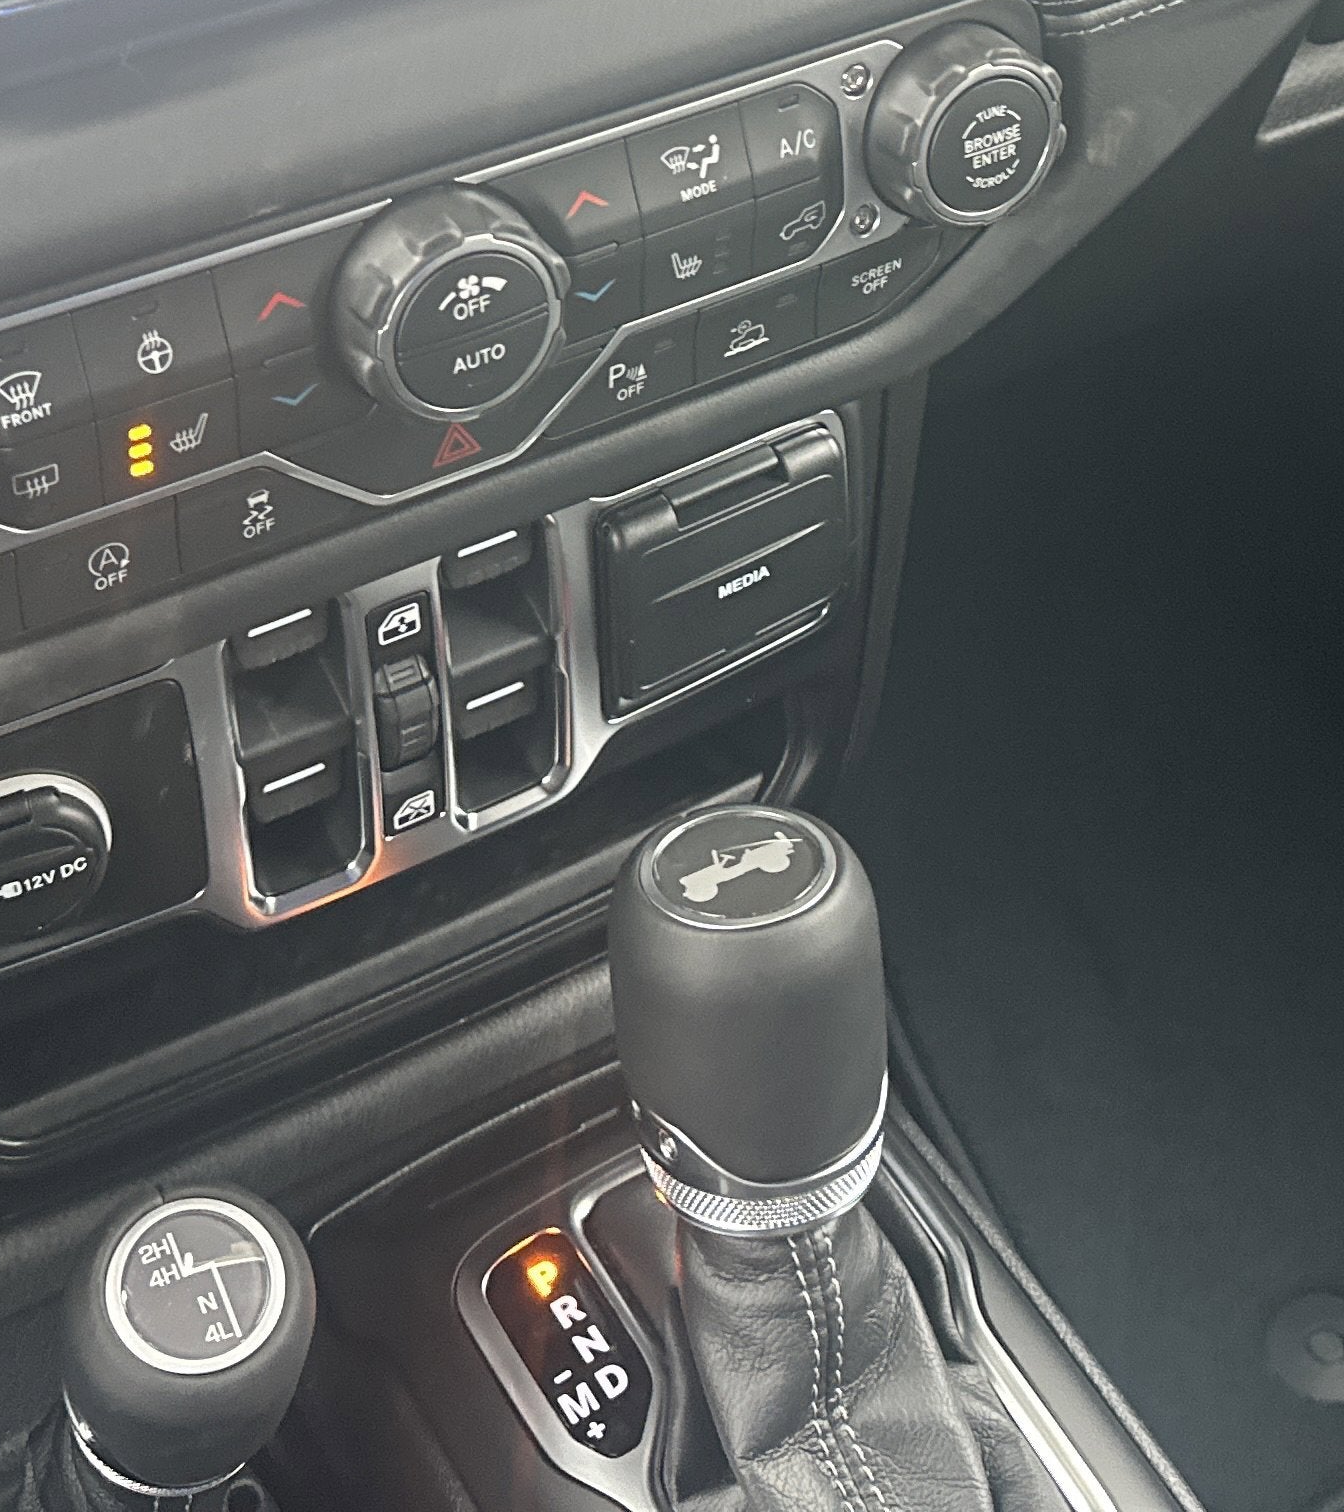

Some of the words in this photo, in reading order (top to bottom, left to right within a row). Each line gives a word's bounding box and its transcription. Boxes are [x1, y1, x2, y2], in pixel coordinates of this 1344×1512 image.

[976, 105, 1007, 122] TUNE
[779, 127, 816, 159] A/C
[964, 124, 1021, 154] BROWSE
[972, 144, 1016, 169] ENTER
[680, 179, 717, 202] MODE
[972, 167, 1016, 188] SCROLL
[851, 257, 902, 288] SCREEN
[862, 274, 888, 296] OFF
[452, 294, 491, 321] OFF
[452, 342, 506, 375] AUTO
[616, 379, 645, 401] OFF
[0, 401, 52, 430] FRONT
[242, 516, 276, 539] OFF
[94, 568, 128, 591] OFF
[716, 563, 772, 601] MEDIA
[24, 869, 56, 892] 12V
[59, 856, 87, 879] DC
[148, 1264, 181, 1292] 4H
[525, 1259, 560, 1300] P
[196, 1292, 220, 1317] N
[548, 1293, 587, 1332] R
[203, 1321, 233, 1346] 4L
[570, 1331, 611, 1365] N
[596, 1363, 630, 1400] D
[556, 1382, 601, 1427] M
